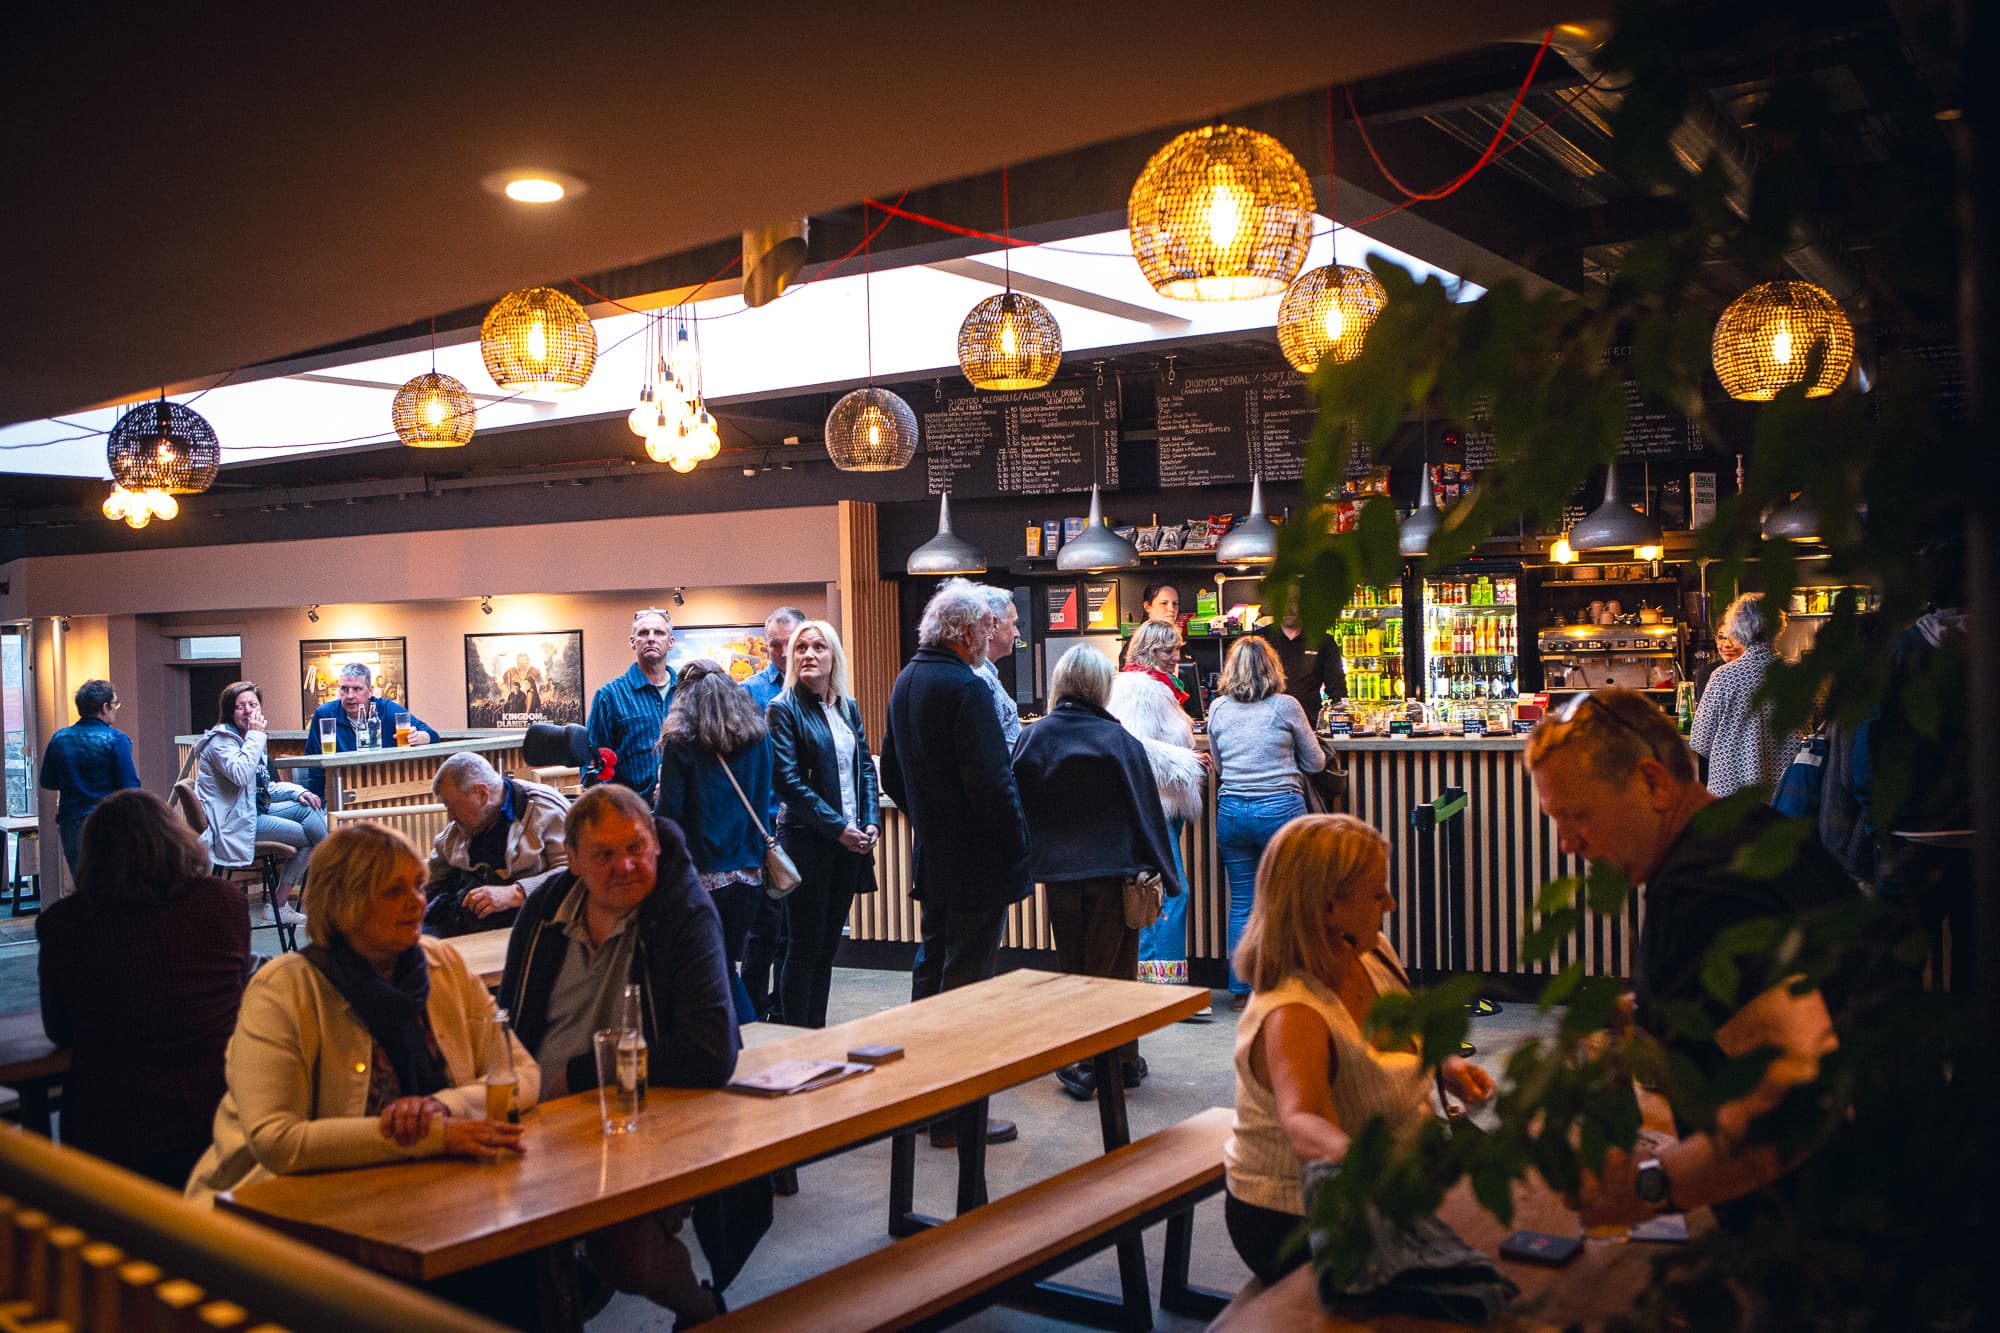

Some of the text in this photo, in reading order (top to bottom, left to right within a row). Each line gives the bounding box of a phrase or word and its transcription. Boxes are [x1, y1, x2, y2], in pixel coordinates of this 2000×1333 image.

[1262, 371, 1285, 382] SOFT
[1061, 388, 1085, 398] DRINKS
[501, 712, 543, 721] KINGDOM
[496, 720, 529, 728] PLANET
